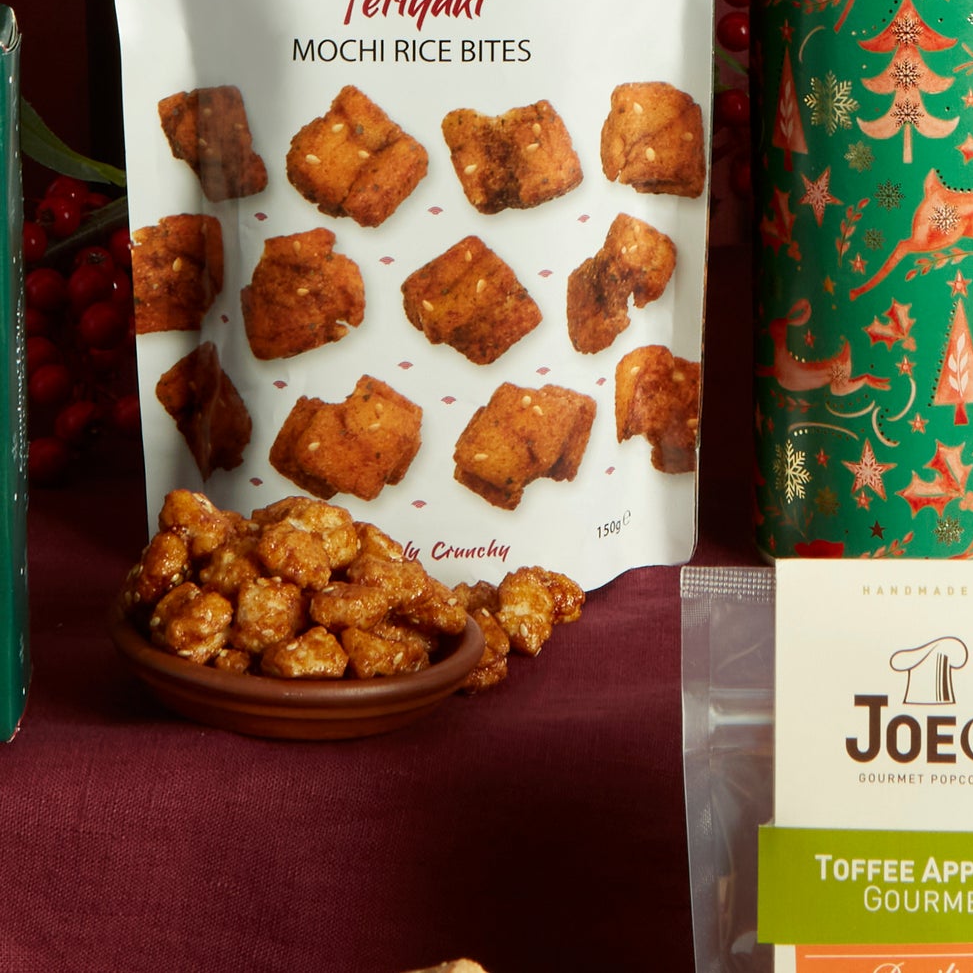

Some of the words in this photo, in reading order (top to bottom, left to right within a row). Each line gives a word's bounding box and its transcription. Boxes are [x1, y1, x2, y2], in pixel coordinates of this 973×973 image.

[293, 39, 386, 62] MOCHI
[394, 39, 452, 62] RICE
[461, 39, 532, 62] BITES
[431, 539, 511, 562] Crunchy
[862, 585, 968, 596] HANDMADE
[845, 694, 957, 763] JOE
[858, 773, 925, 785] GOURMET
[815, 854, 914, 883] TOFFEE
